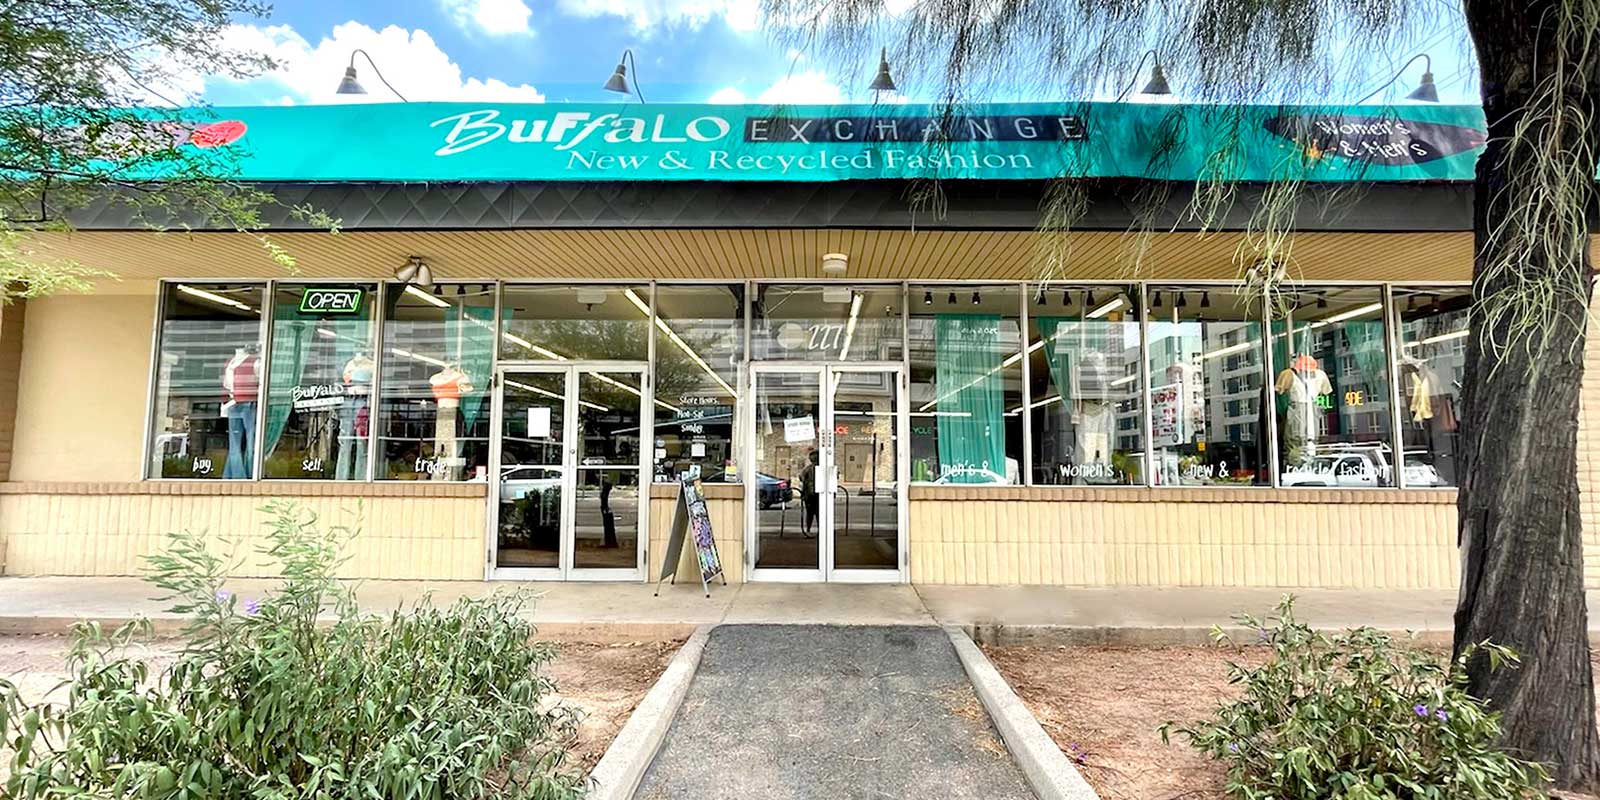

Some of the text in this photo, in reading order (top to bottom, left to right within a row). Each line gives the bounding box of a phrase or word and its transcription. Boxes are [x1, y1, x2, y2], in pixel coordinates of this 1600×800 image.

[751, 117, 1083, 144] EXCHANGE
[1315, 119, 1411, 135] Women's
[566, 150, 1033, 174] New & Recycled Fashion
[308, 292, 358, 310] OPEN
[808, 324, 843, 350] 227
[940, 459, 975, 477] men's
[1060, 462, 1114, 478] women's
[1190, 460, 1229, 478] new &
